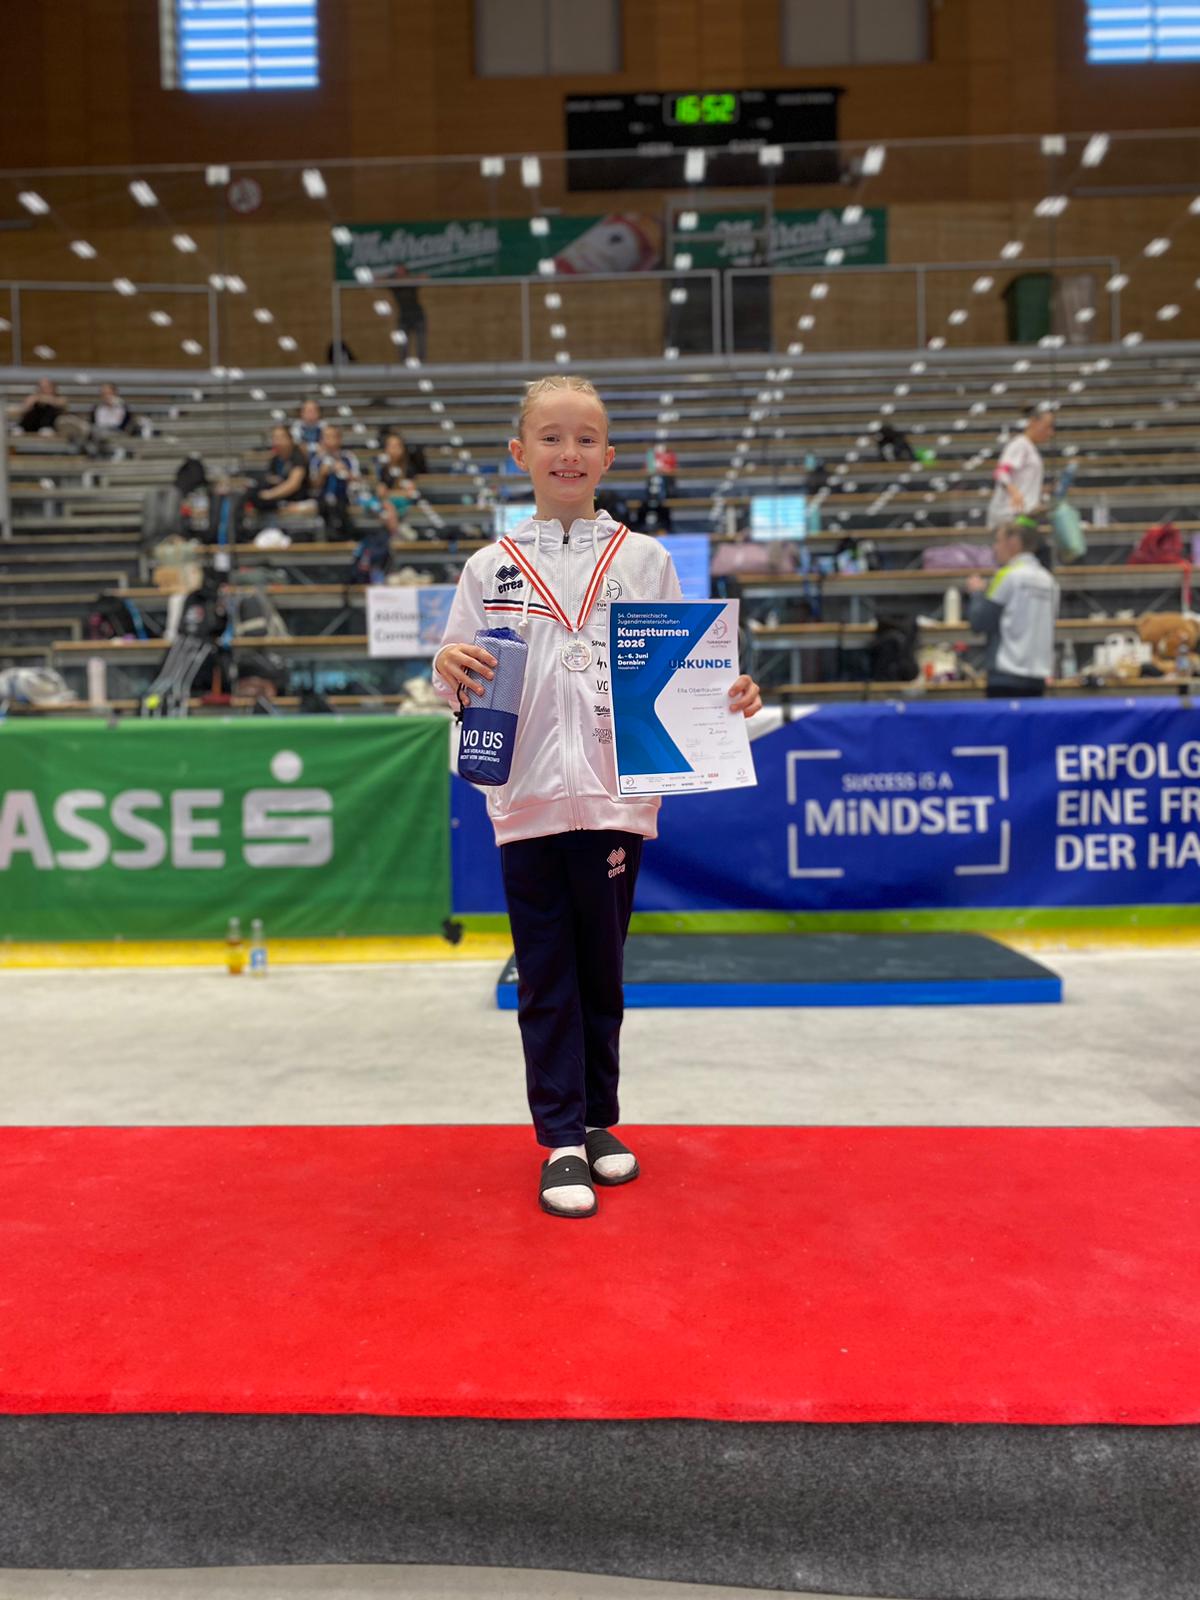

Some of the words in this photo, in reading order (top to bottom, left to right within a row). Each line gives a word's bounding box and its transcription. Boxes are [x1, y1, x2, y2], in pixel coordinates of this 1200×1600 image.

[617, 627, 690, 637] Kunstturnen
[617, 638, 646, 648] 2026
[668, 659, 732, 669] URKUNDE
[463, 730, 480, 747] VO
[482, 730, 504, 749] ÜS
[1055, 740, 1200, 782] ERFOLG
[842, 773, 917, 792] SUCCESS
[938, 771, 954, 791] A
[1057, 788, 1149, 827] EINE
[1055, 834, 1137, 872] DER
